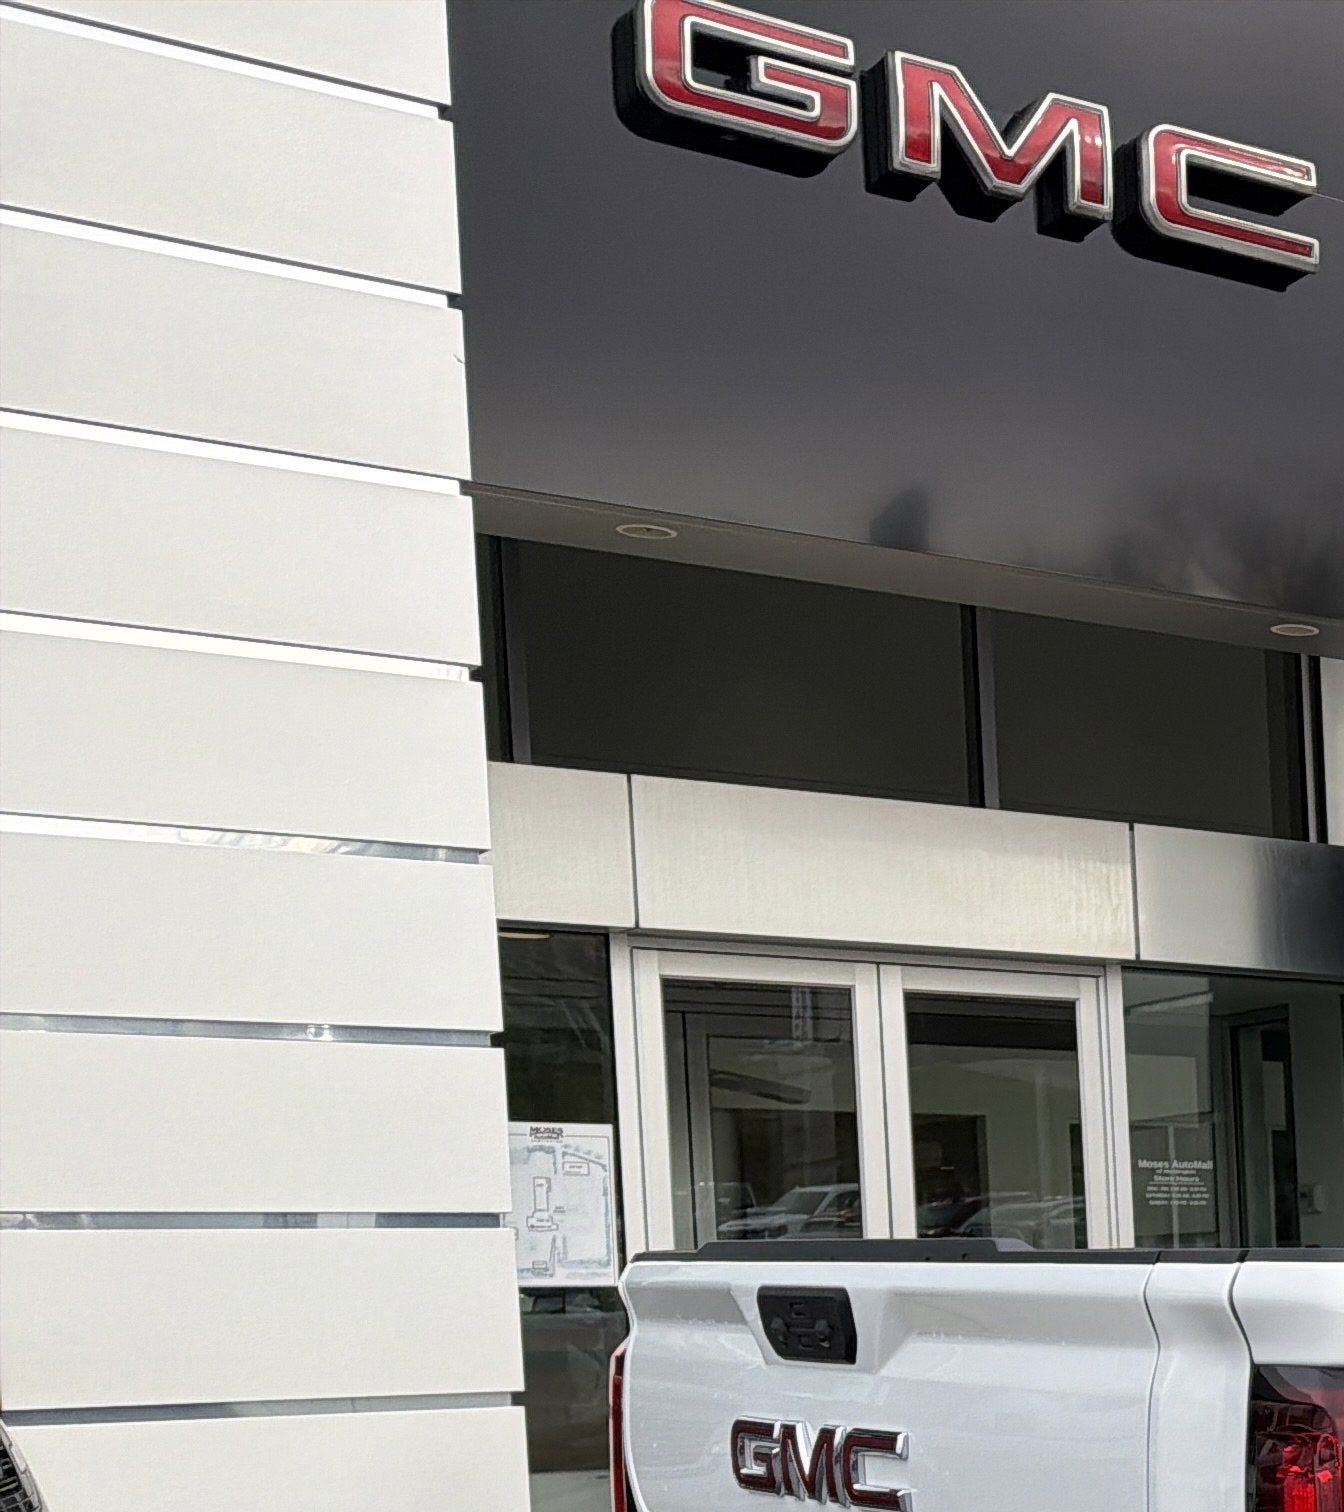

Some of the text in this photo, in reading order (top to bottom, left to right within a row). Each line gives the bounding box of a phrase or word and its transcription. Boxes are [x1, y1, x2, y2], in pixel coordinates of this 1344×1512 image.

[630, 0, 1320, 278] GMC
[1138, 1159, 1214, 1170] Moses AutoMall
